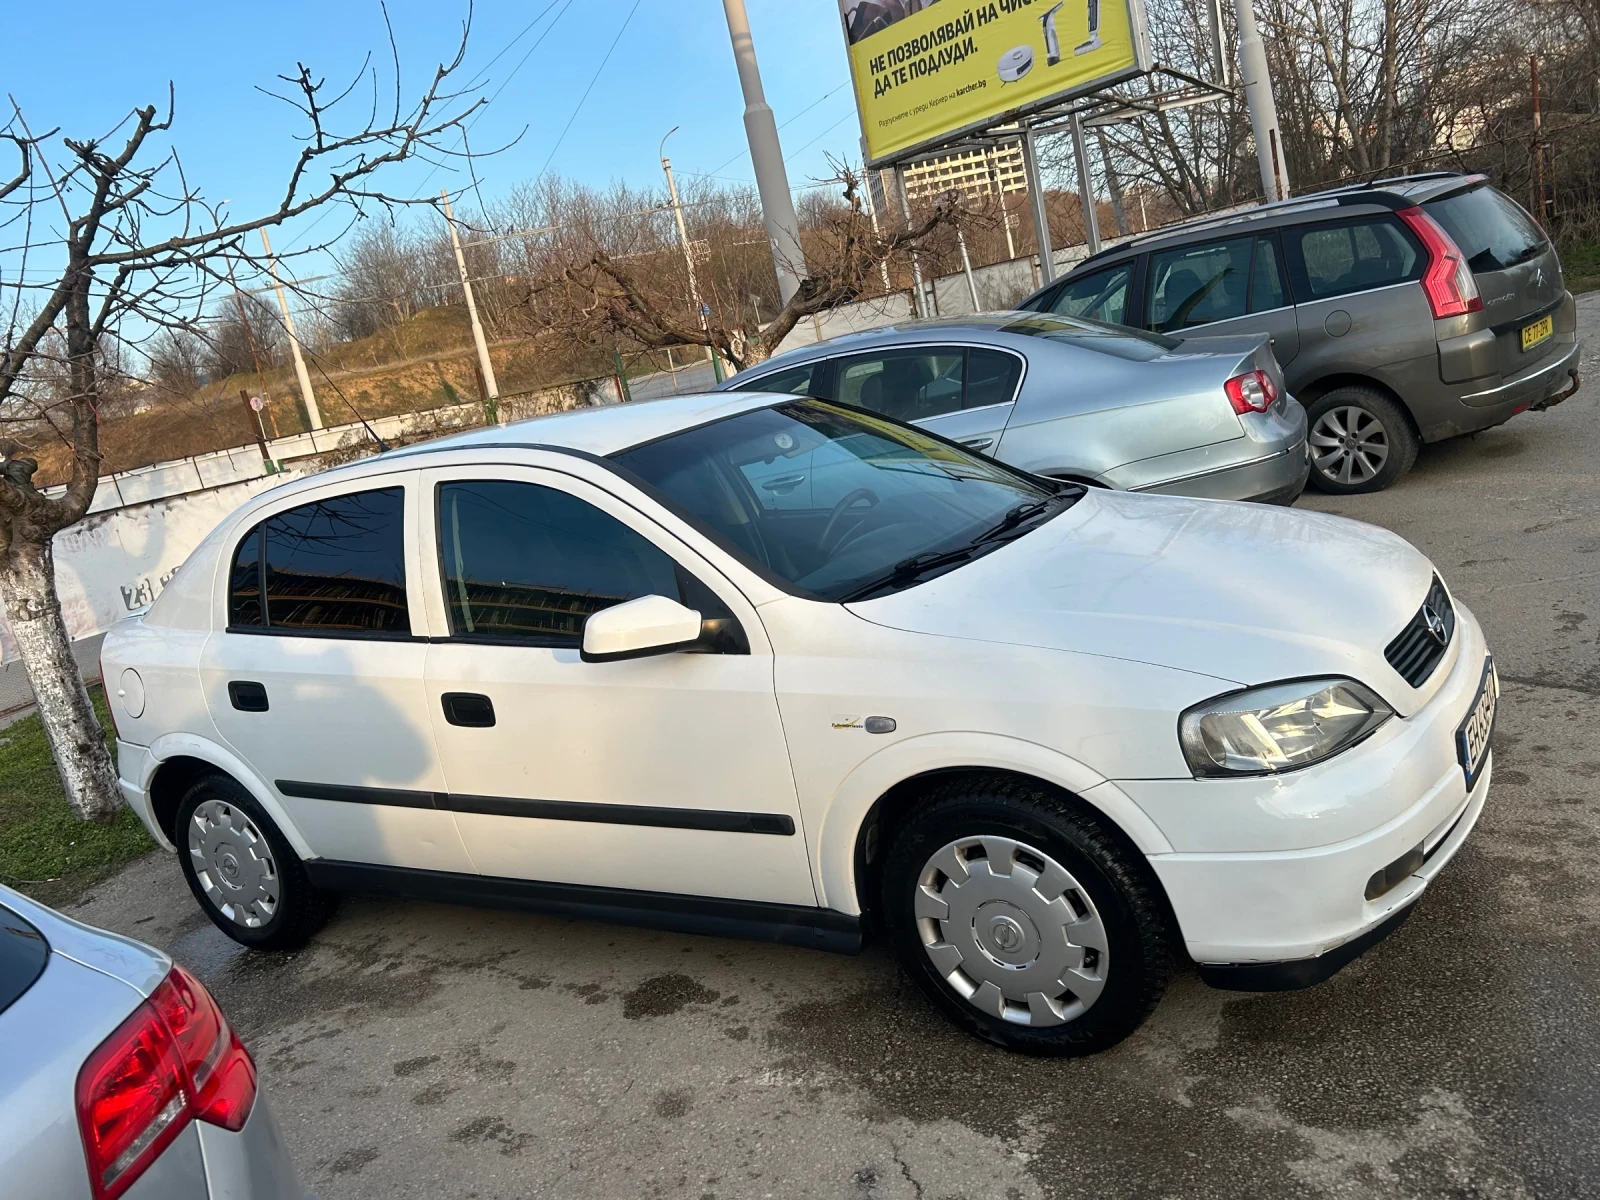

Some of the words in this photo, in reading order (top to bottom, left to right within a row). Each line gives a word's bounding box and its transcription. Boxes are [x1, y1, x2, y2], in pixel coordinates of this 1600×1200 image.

[869, 55, 885, 75] НЕ
[888, 9, 975, 68] ПОЗВОЛЯВАЙ
[976, 6, 999, 27] НА
[874, 75, 893, 99] ДА
[892, 67, 908, 88] ТЕ
[909, 36, 979, 80] ПОДЛУДИ.
[912, 103, 929, 116] уреди
[948, 91, 956, 100] на
